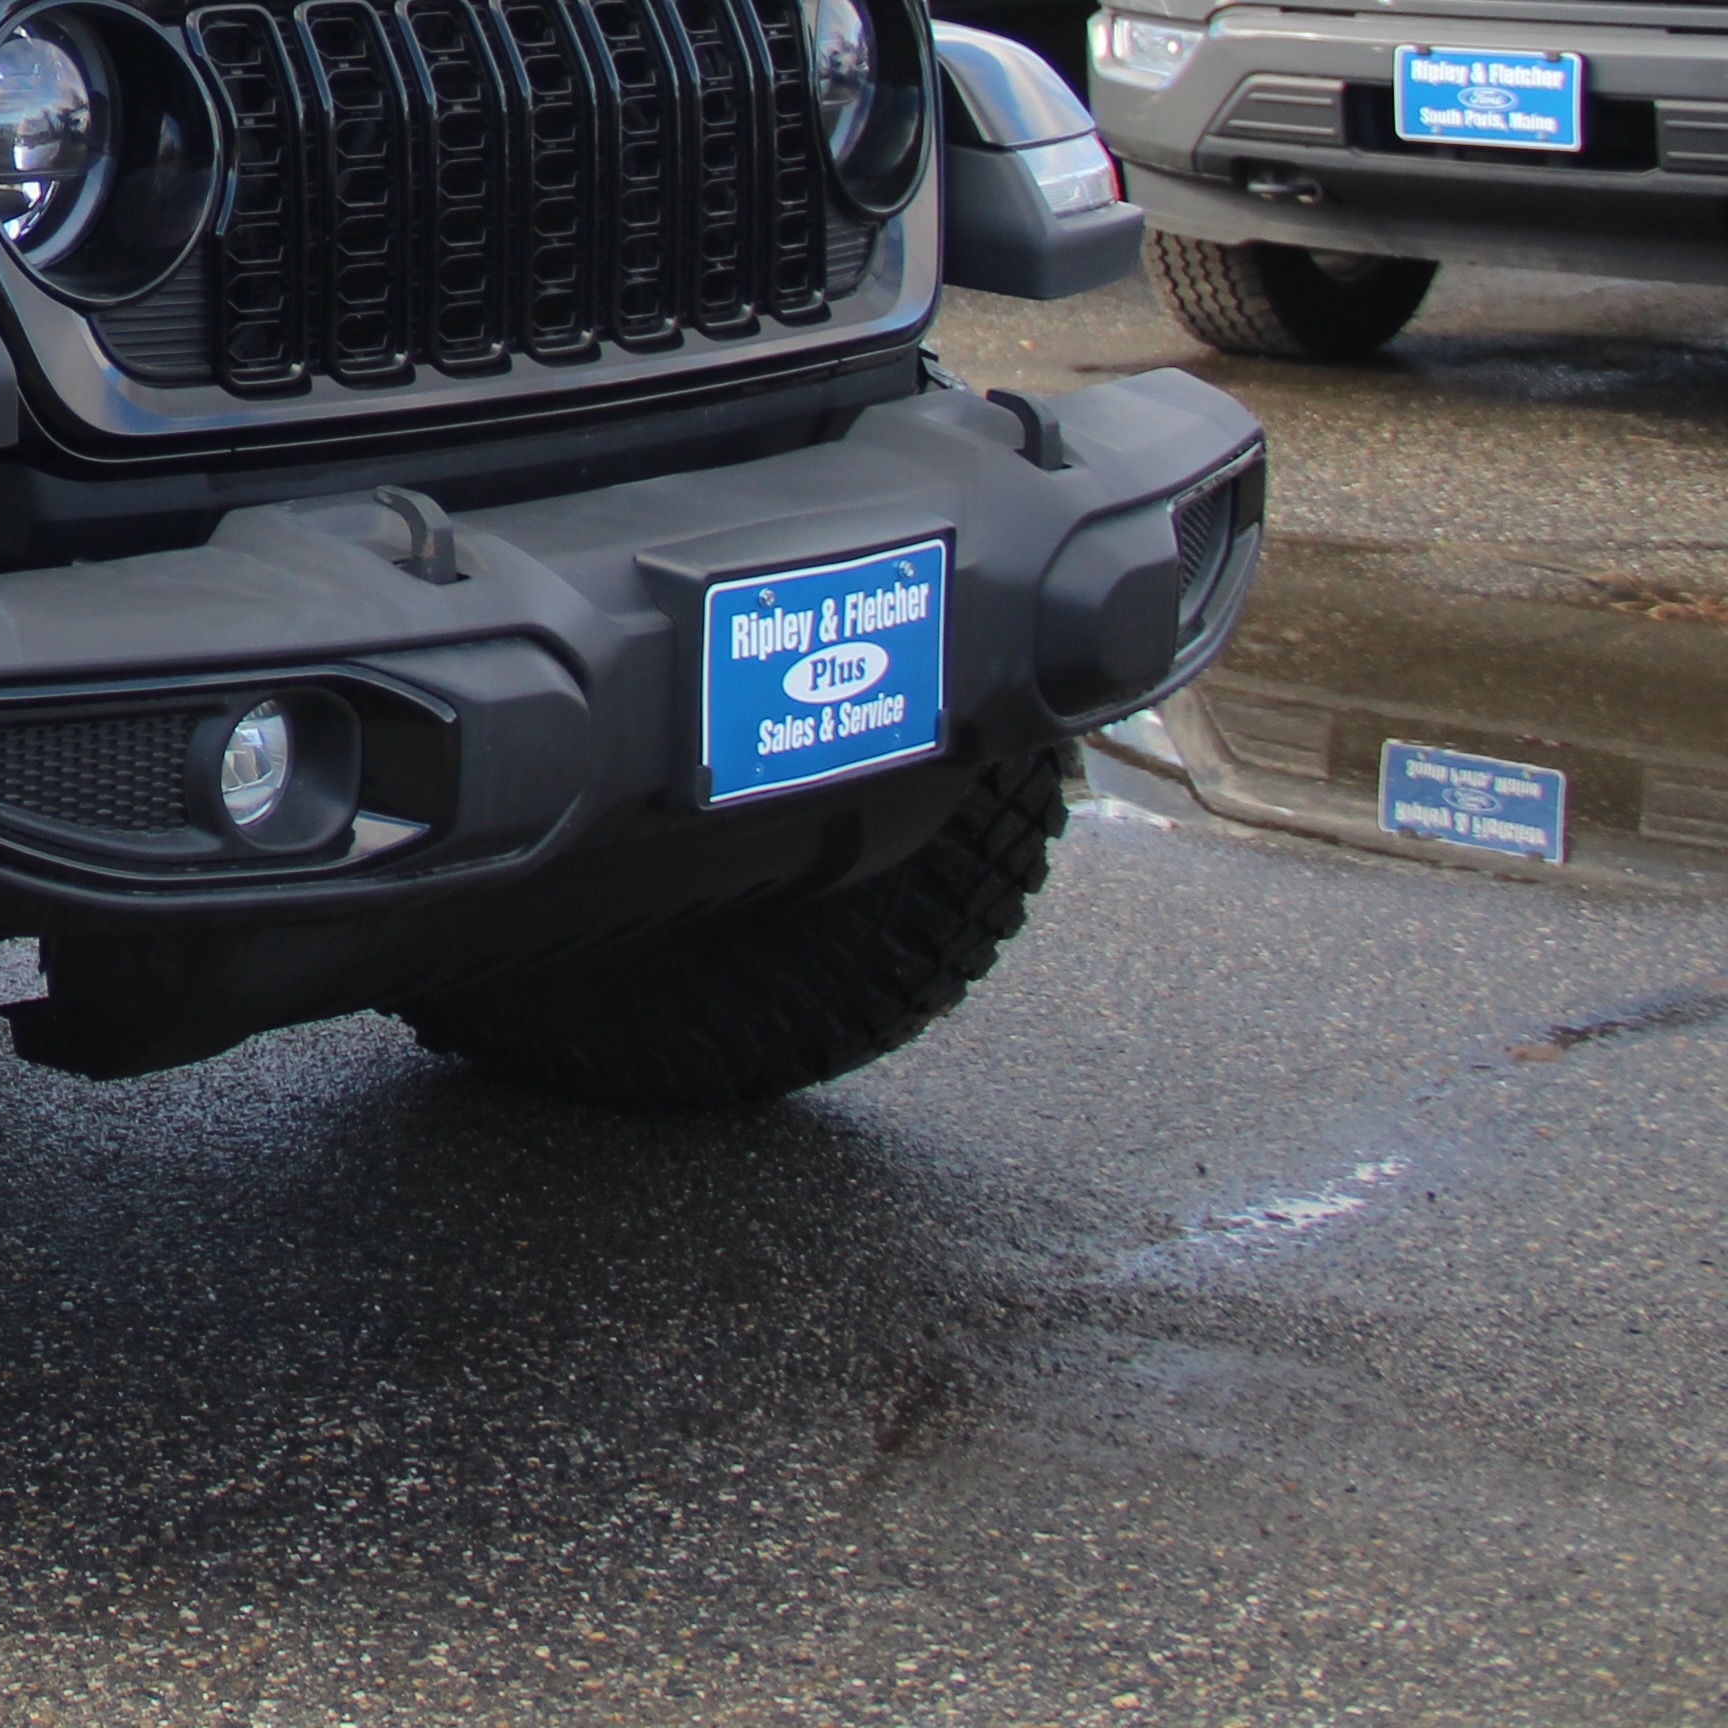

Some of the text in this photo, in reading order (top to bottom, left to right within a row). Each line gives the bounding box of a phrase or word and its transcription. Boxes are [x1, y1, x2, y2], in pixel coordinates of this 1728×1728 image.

[1411, 59, 1565, 89] Ripley & Fletcher
[1469, 89, 1505, 105] Ford
[1419, 107, 1463, 128] South
[1509, 112, 1558, 133] Maine
[731, 582, 929, 661] Ripley & Fletcher
[808, 654, 866, 691] Plus
[757, 693, 905, 756] Sales & Service
